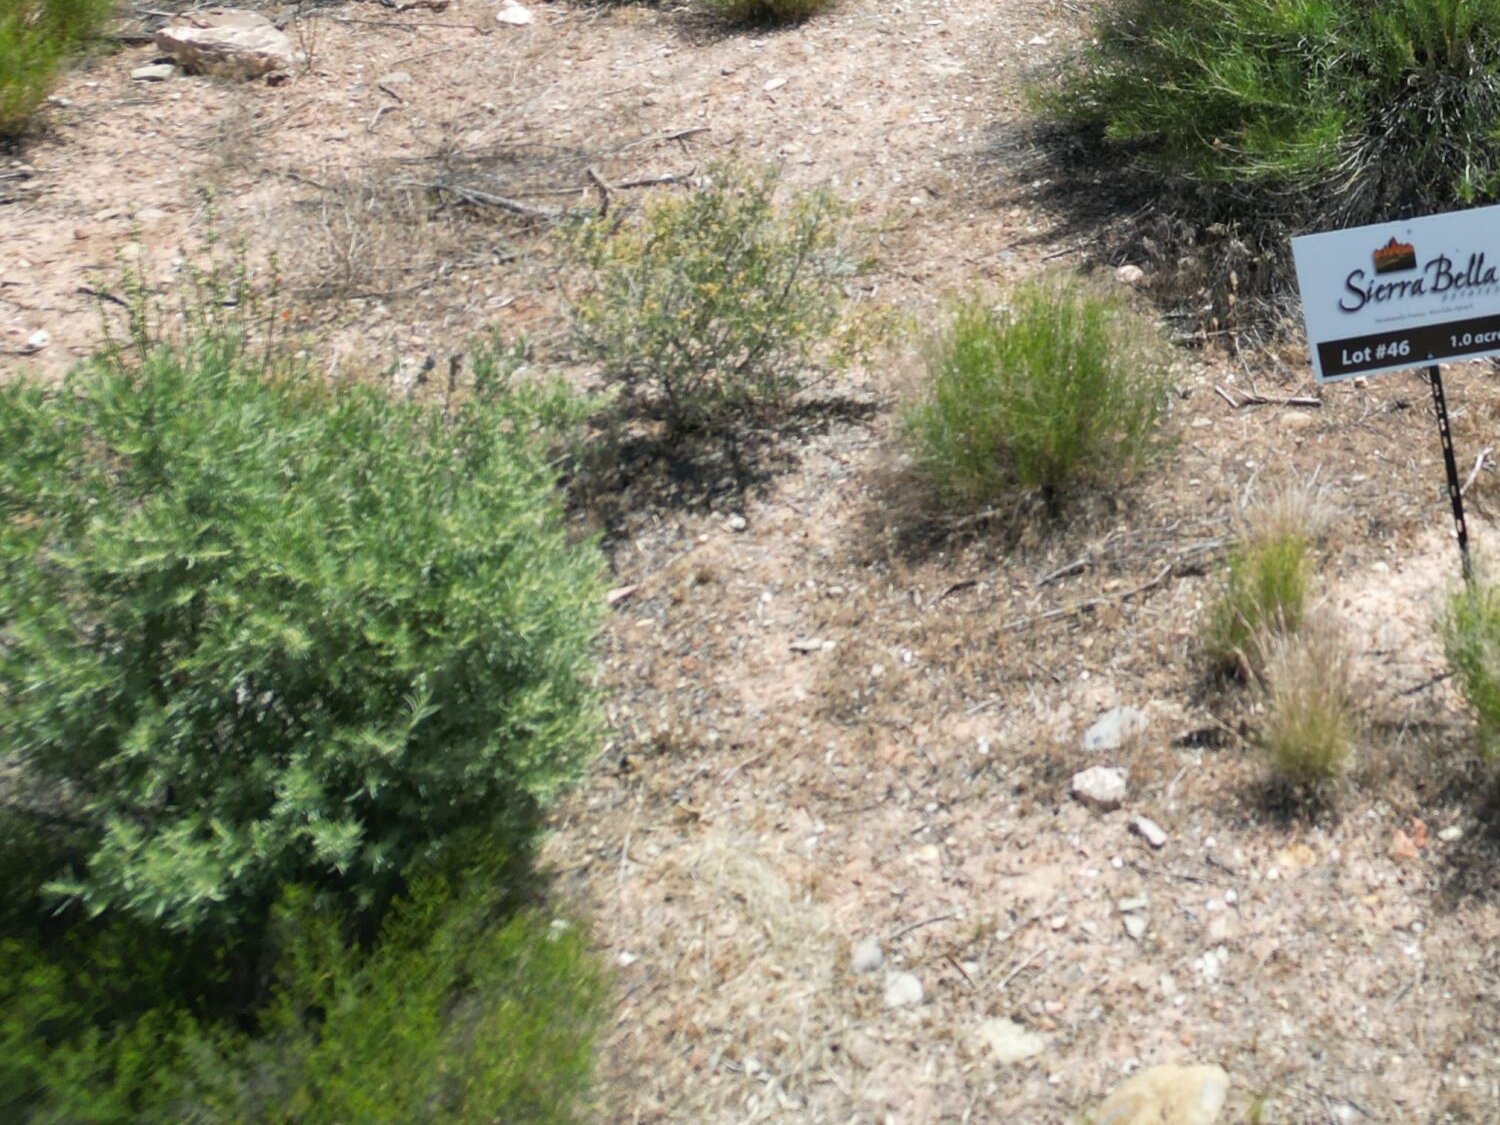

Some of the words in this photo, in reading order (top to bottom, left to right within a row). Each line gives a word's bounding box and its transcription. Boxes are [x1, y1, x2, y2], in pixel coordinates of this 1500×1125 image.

[1338, 268, 1425, 312] Sierra
[1424, 252, 1499, 293] Bella
[1342, 348, 1371, 366] Lot
[1375, 340, 1411, 361] #46
[1450, 333, 1473, 348] 1.0
